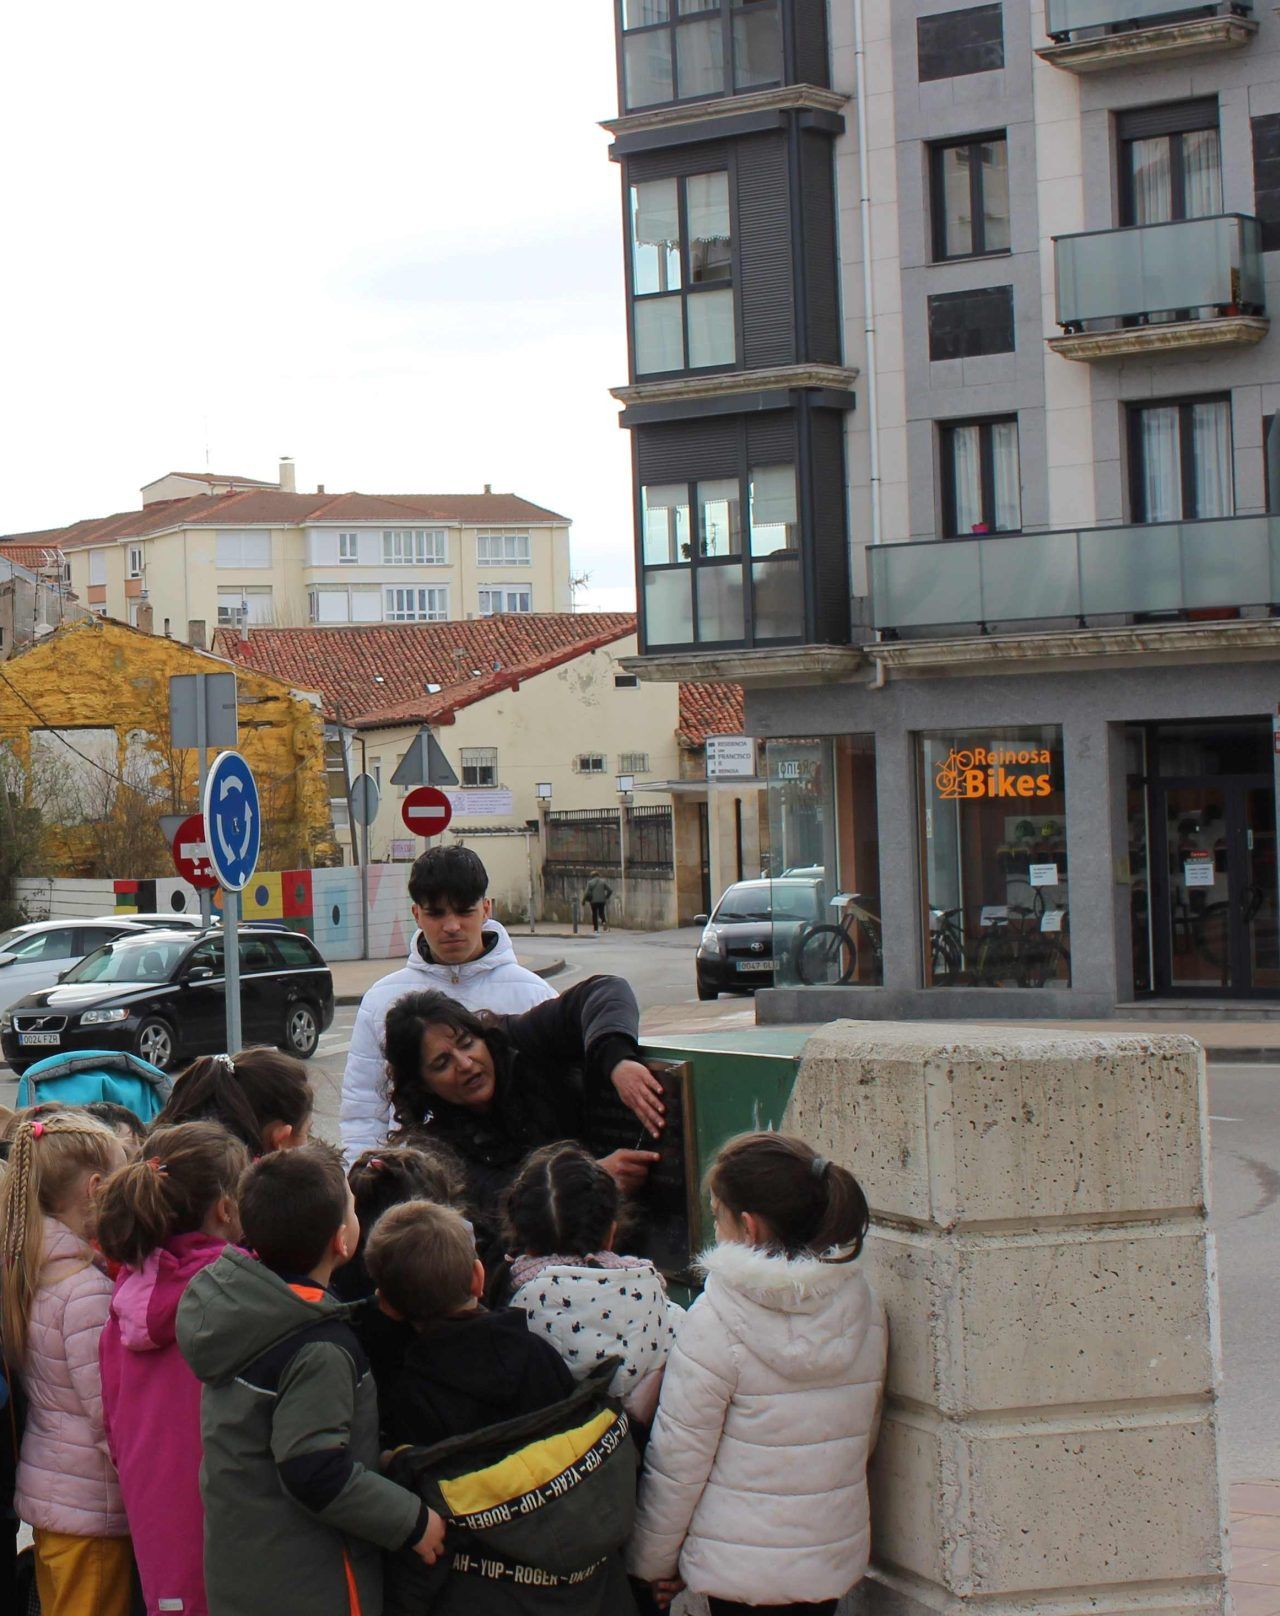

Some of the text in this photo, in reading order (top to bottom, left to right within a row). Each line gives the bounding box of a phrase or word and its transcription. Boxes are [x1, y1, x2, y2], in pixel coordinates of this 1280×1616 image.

[974, 747, 1051, 766] Reinosa
[966, 767, 1052, 798] Bikes
[24, 1034, 58, 1044] 0024 FZR
